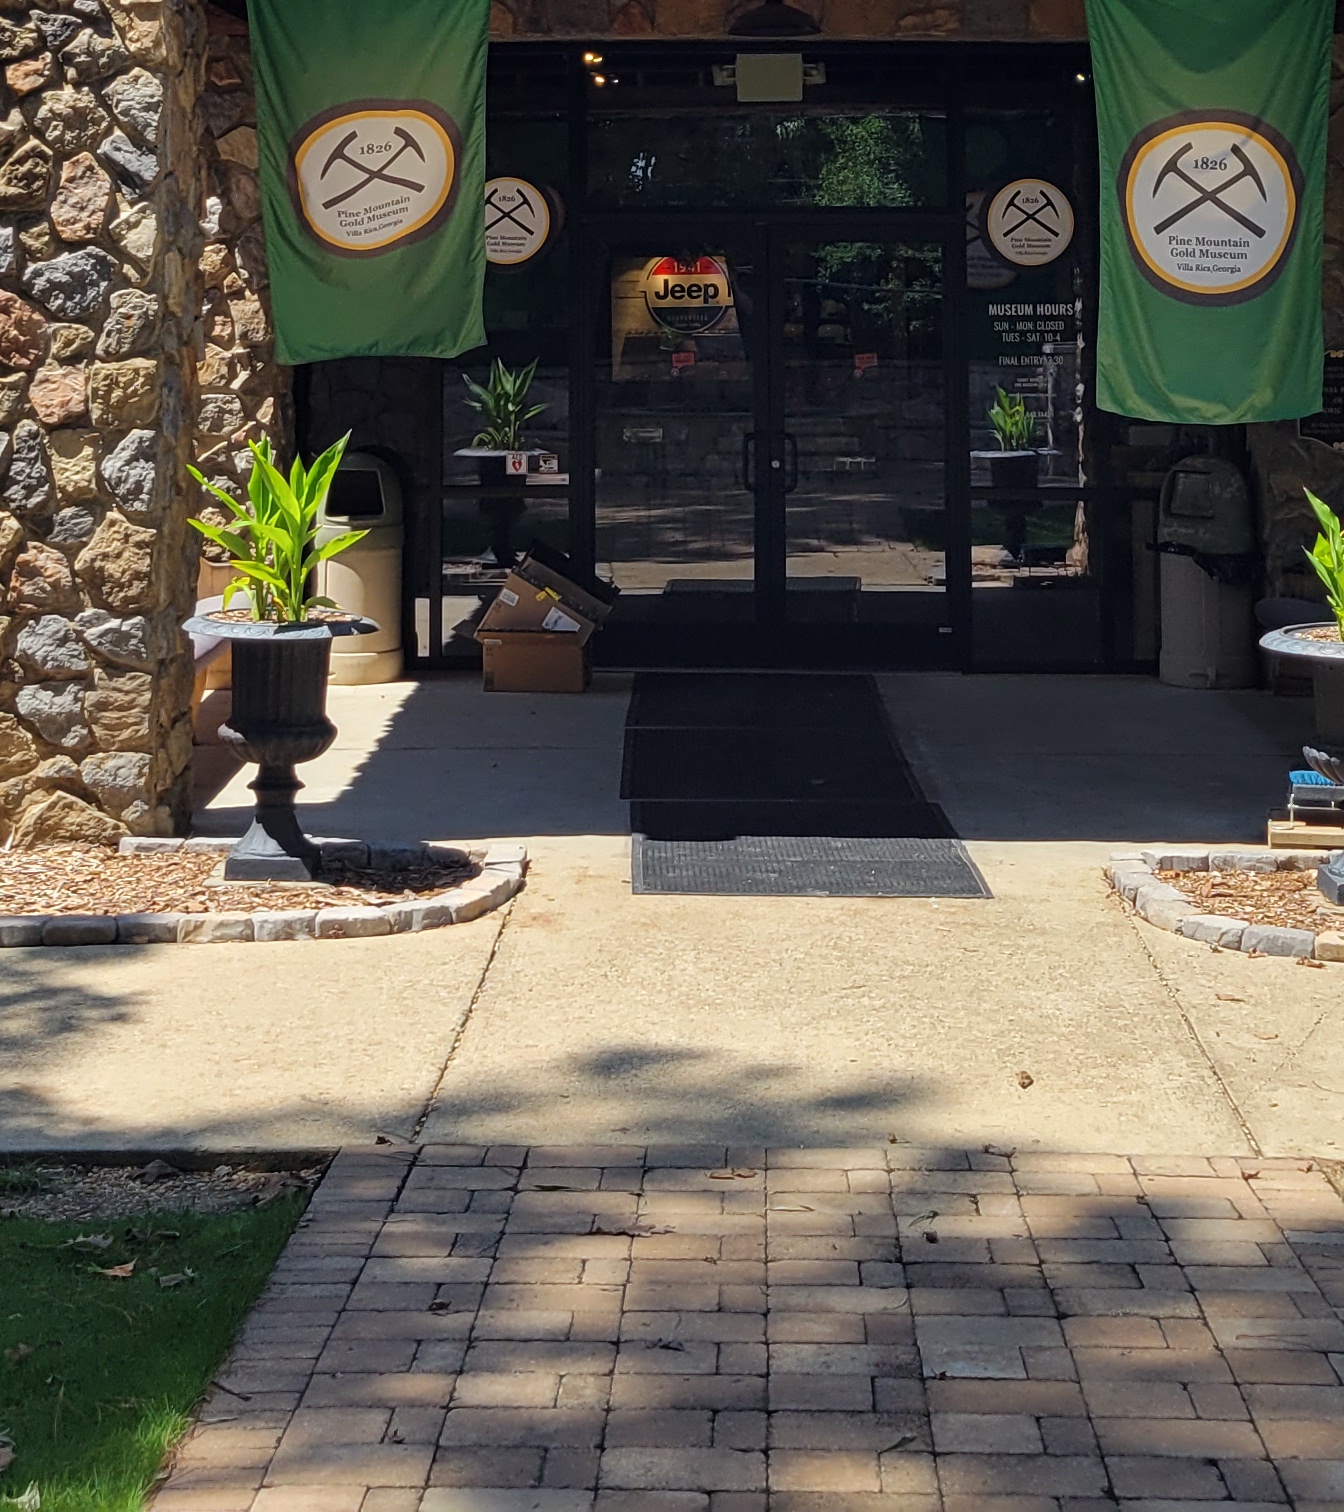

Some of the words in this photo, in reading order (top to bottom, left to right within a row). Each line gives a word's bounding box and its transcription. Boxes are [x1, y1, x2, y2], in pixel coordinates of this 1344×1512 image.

[358, 141, 392, 155] 1826
[1193, 156, 1227, 171] 1826
[498, 194, 516, 202] 1826
[1021, 196, 1039, 204] 1826
[336, 210, 362, 219] Pine
[363, 195, 411, 216] Mountain
[339, 216, 364, 228] Gold
[366, 206, 409, 224] Museum
[1168, 235, 1193, 246] Pine
[1195, 237, 1250, 248] Mountain
[1170, 248, 1196, 258] Gold
[1198, 249, 1248, 260] Museum
[673, 261, 701, 273] 1941
[1176, 263, 1194, 272] Villa
[654, 278, 719, 304] Jeep
[988, 303, 1034, 316] MUSEUM
[1036, 303, 1074, 316] HOURS
[993, 321, 1009, 331] SUN
[1036, 321, 1065, 330] CLOSED
[1002, 333, 1020, 342] TUES
[1044, 333, 1061, 342] 10-4
[998, 356, 1019, 365] FINAL
